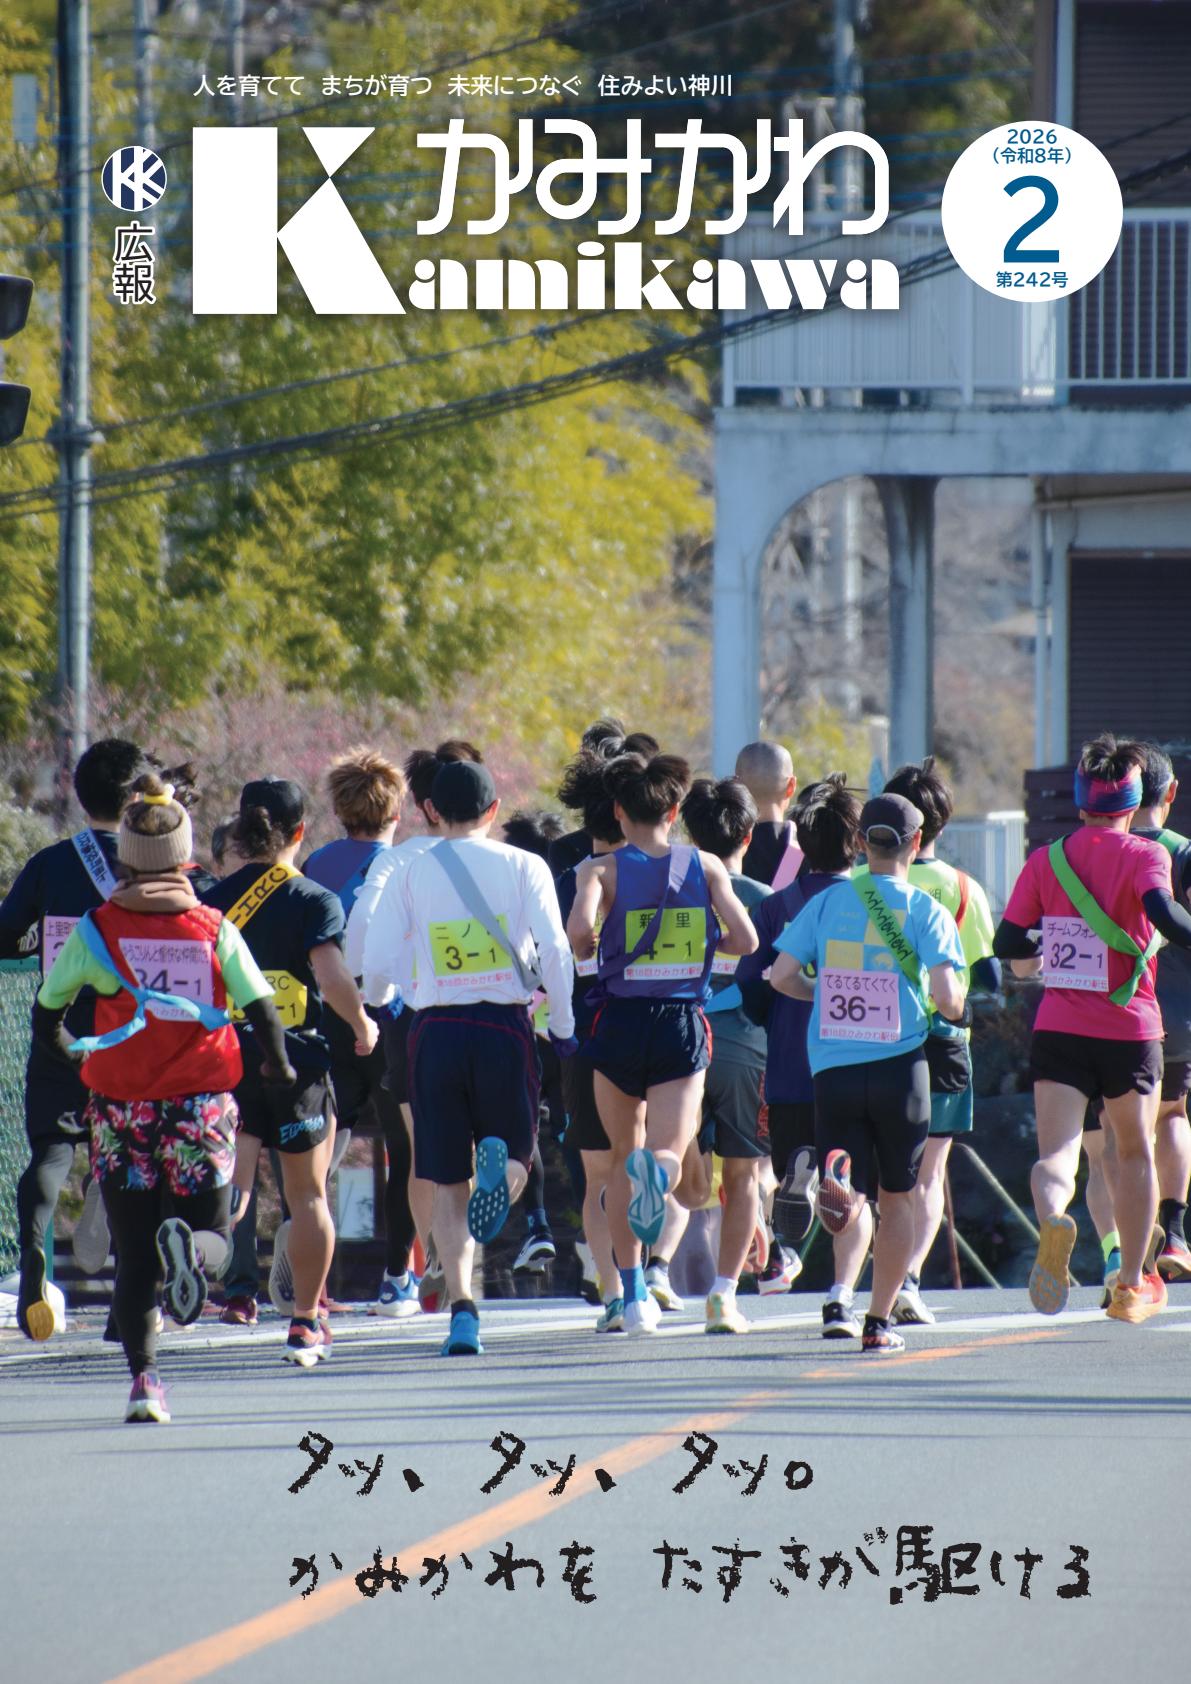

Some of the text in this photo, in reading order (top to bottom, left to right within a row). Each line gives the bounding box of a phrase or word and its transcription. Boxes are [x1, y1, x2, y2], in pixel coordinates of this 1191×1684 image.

[445, 945, 497, 970] 3-1
[1050, 942, 1103, 970] 32-1
[824, 974, 897, 993] てるてるてくてく
[829, 994, 892, 1022] 36-1
